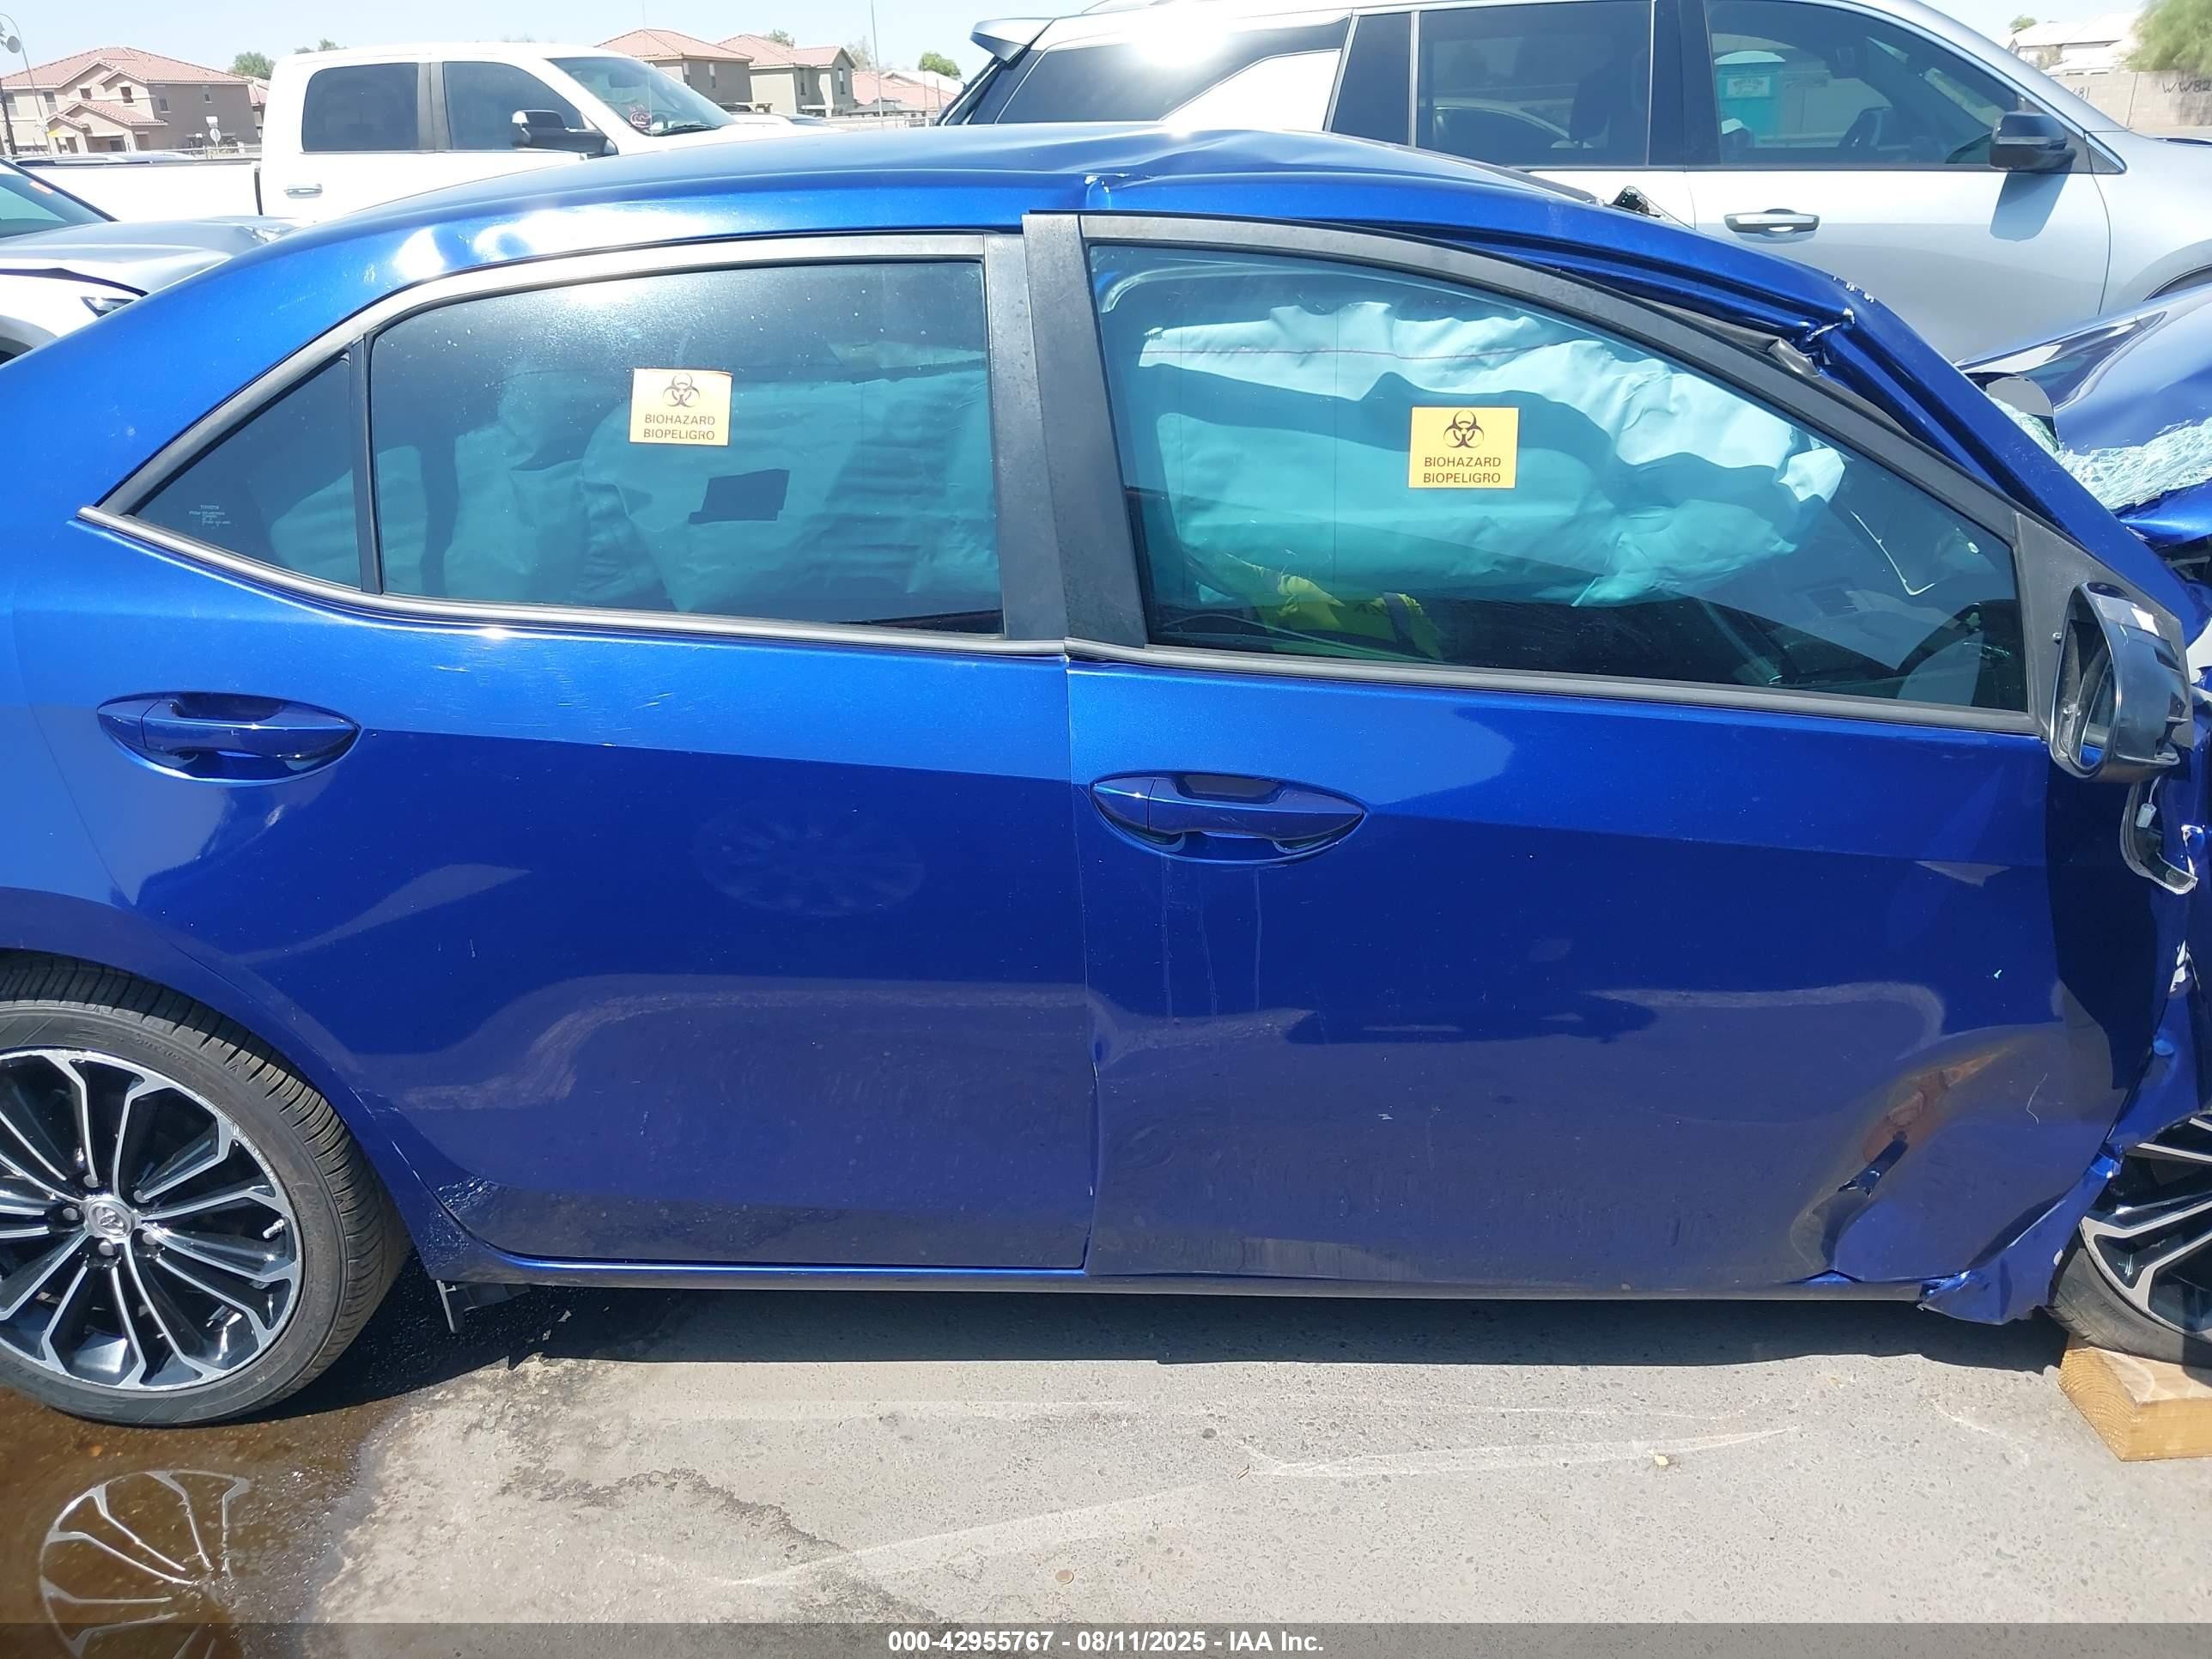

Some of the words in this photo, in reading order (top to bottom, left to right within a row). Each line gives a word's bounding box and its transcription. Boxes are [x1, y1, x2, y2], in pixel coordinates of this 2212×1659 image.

[645, 413, 715, 426] BIOHAZARD
[643, 428, 714, 441] BIOPELIGRO
[1424, 456, 1501, 467] BIOHAZARD
[1423, 472, 1501, 483] BIOPELIGRO
